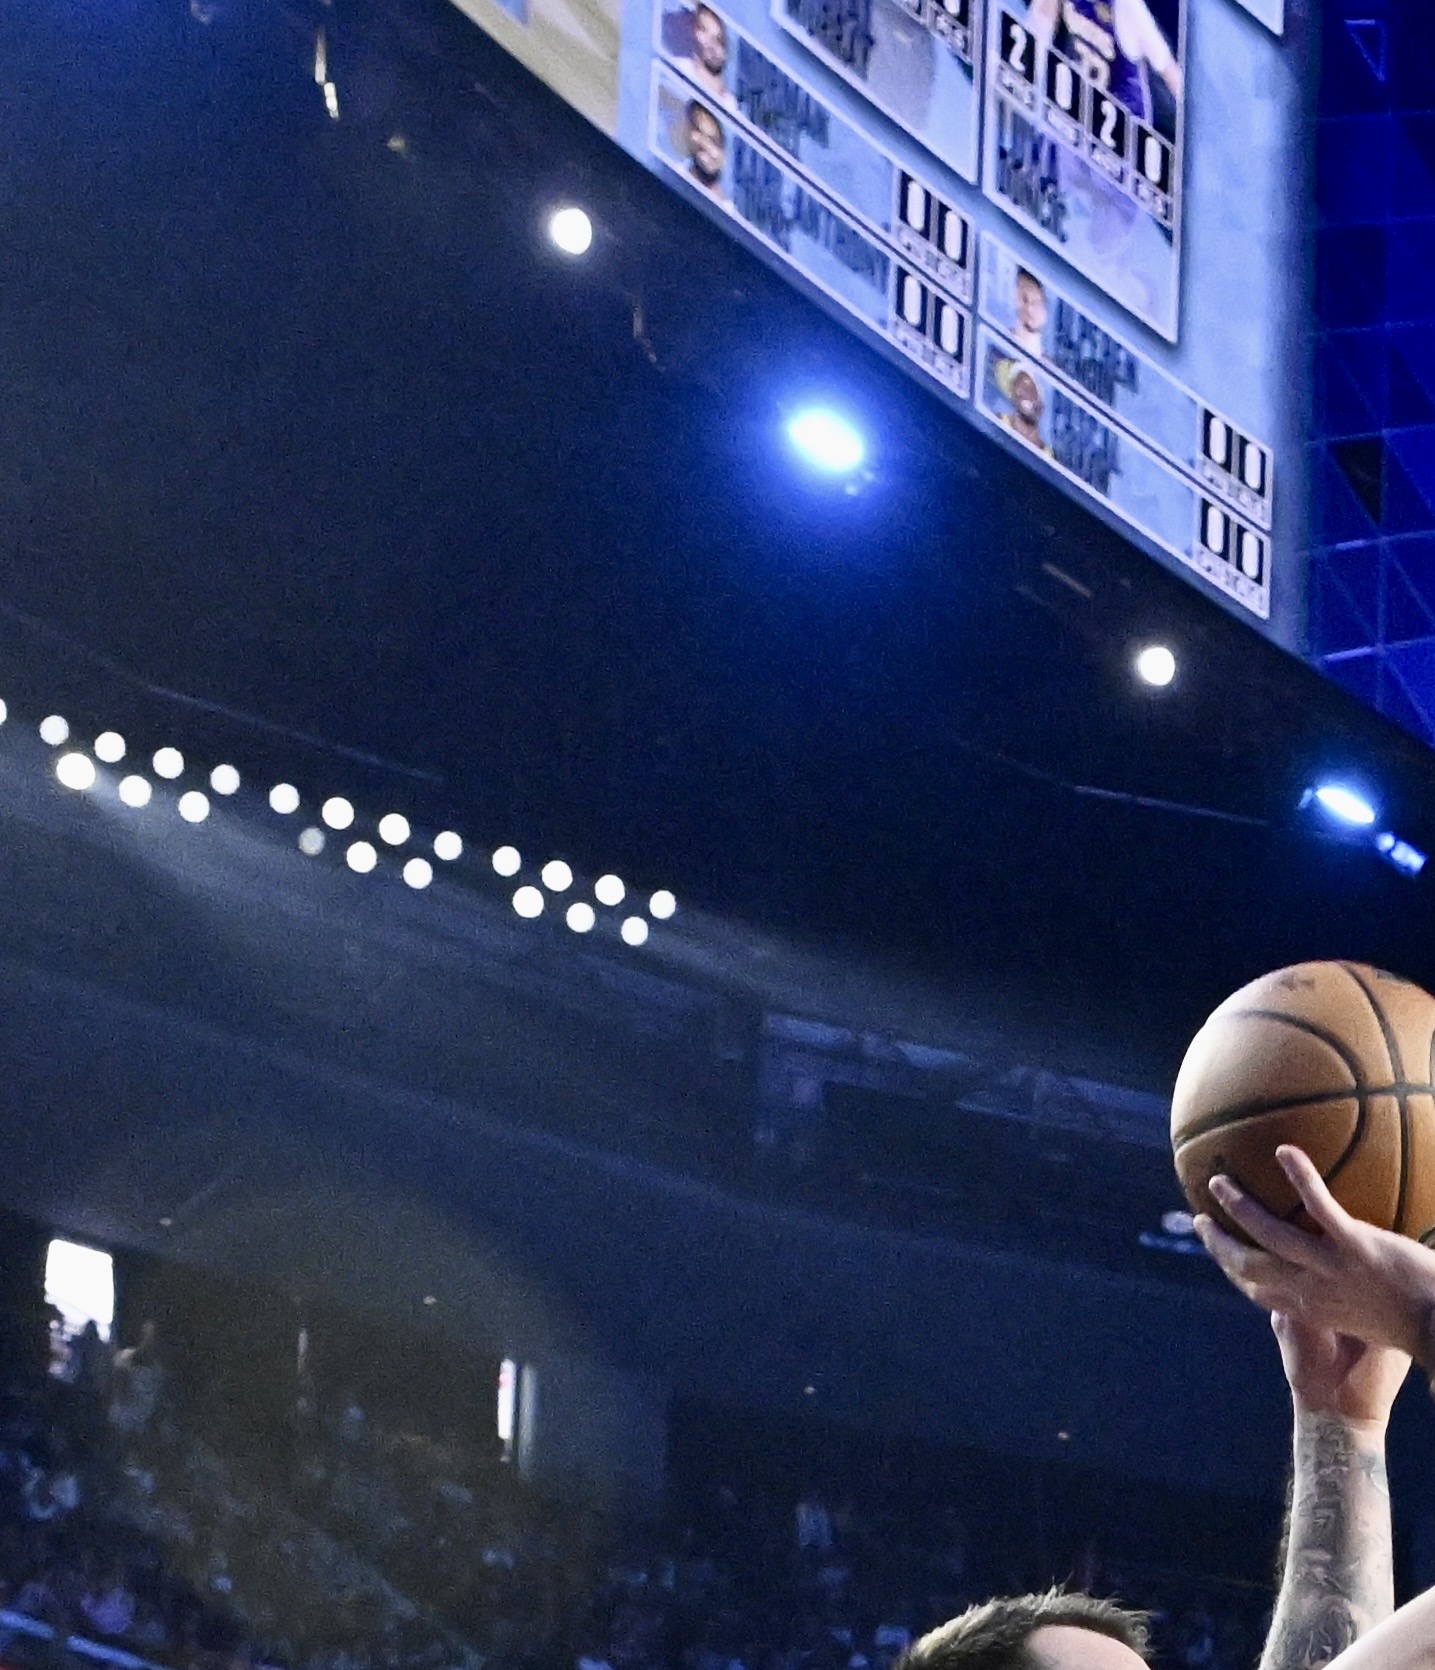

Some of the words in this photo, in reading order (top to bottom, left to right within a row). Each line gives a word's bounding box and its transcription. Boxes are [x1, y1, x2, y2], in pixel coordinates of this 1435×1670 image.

[1009, 23, 1027, 72] 2
[1055, 61, 1073, 110] 0
[1100, 100, 1117, 149] 2
[1144, 136, 1162, 184] 0
